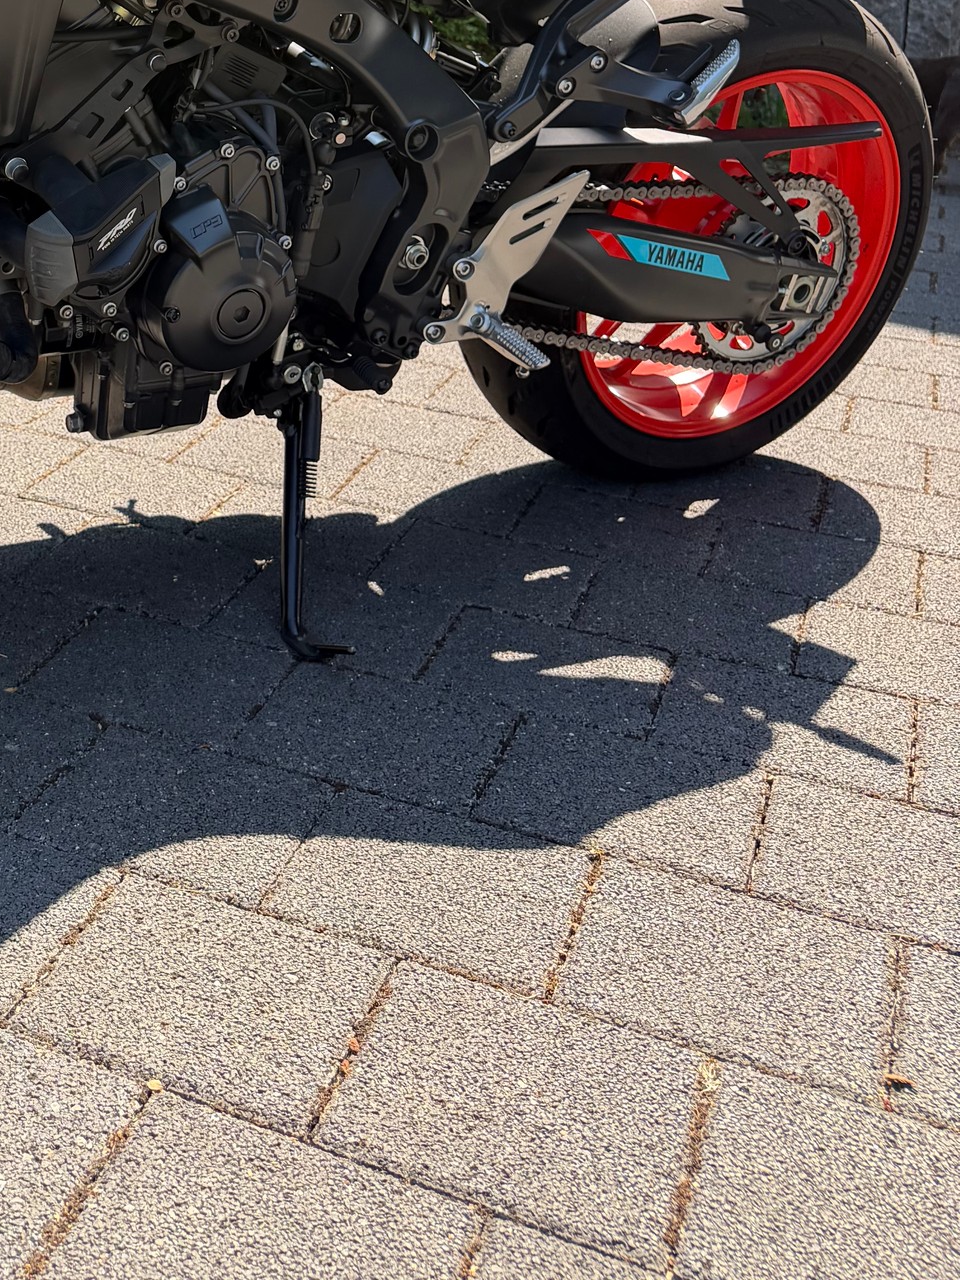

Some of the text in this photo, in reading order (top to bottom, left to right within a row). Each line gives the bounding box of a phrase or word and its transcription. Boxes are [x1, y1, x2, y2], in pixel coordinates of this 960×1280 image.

[192, 214, 223, 239] CP3
[896, 172, 922, 269] MICHELIN
[648, 243, 705, 273] YAMAHA
